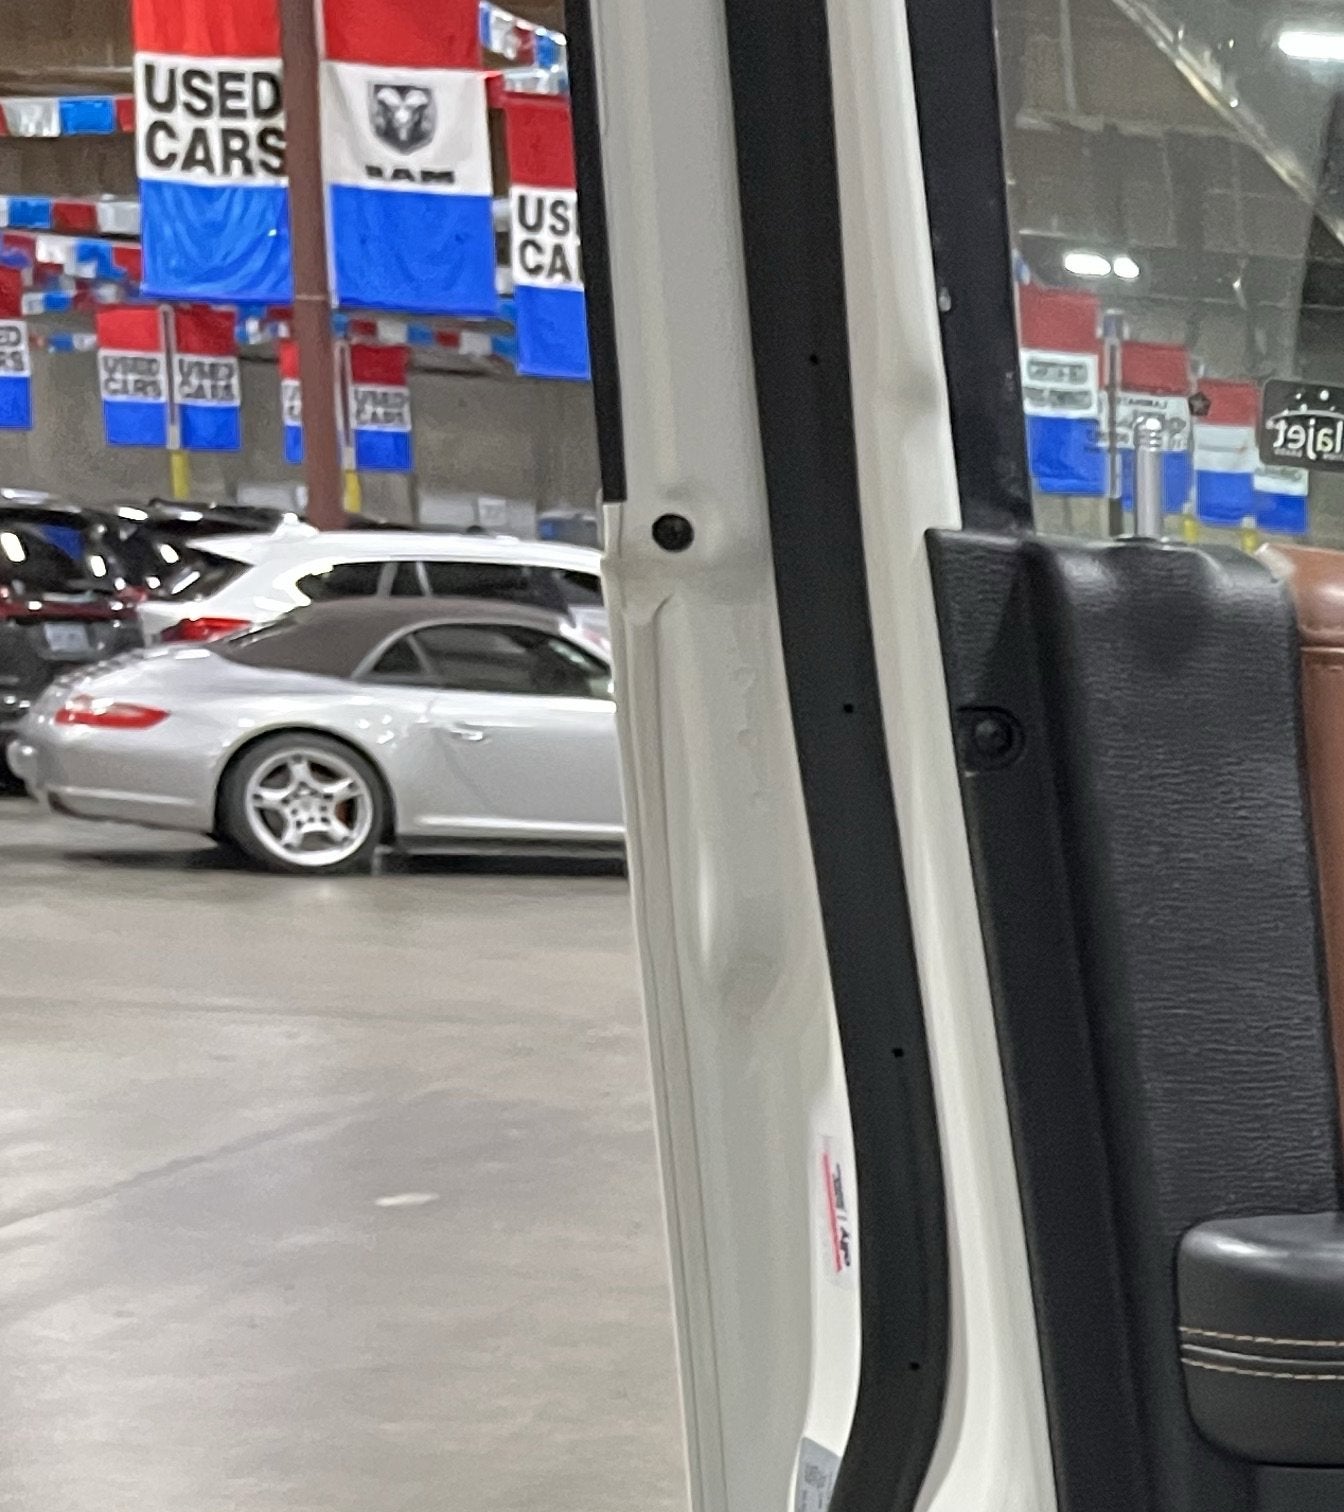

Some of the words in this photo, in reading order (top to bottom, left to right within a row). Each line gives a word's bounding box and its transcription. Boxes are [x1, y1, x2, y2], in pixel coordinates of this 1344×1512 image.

[144, 64, 282, 119] USED
[145, 120, 286, 177] CARS
[518, 194, 580, 237] US
[519, 238, 583, 281] CA
